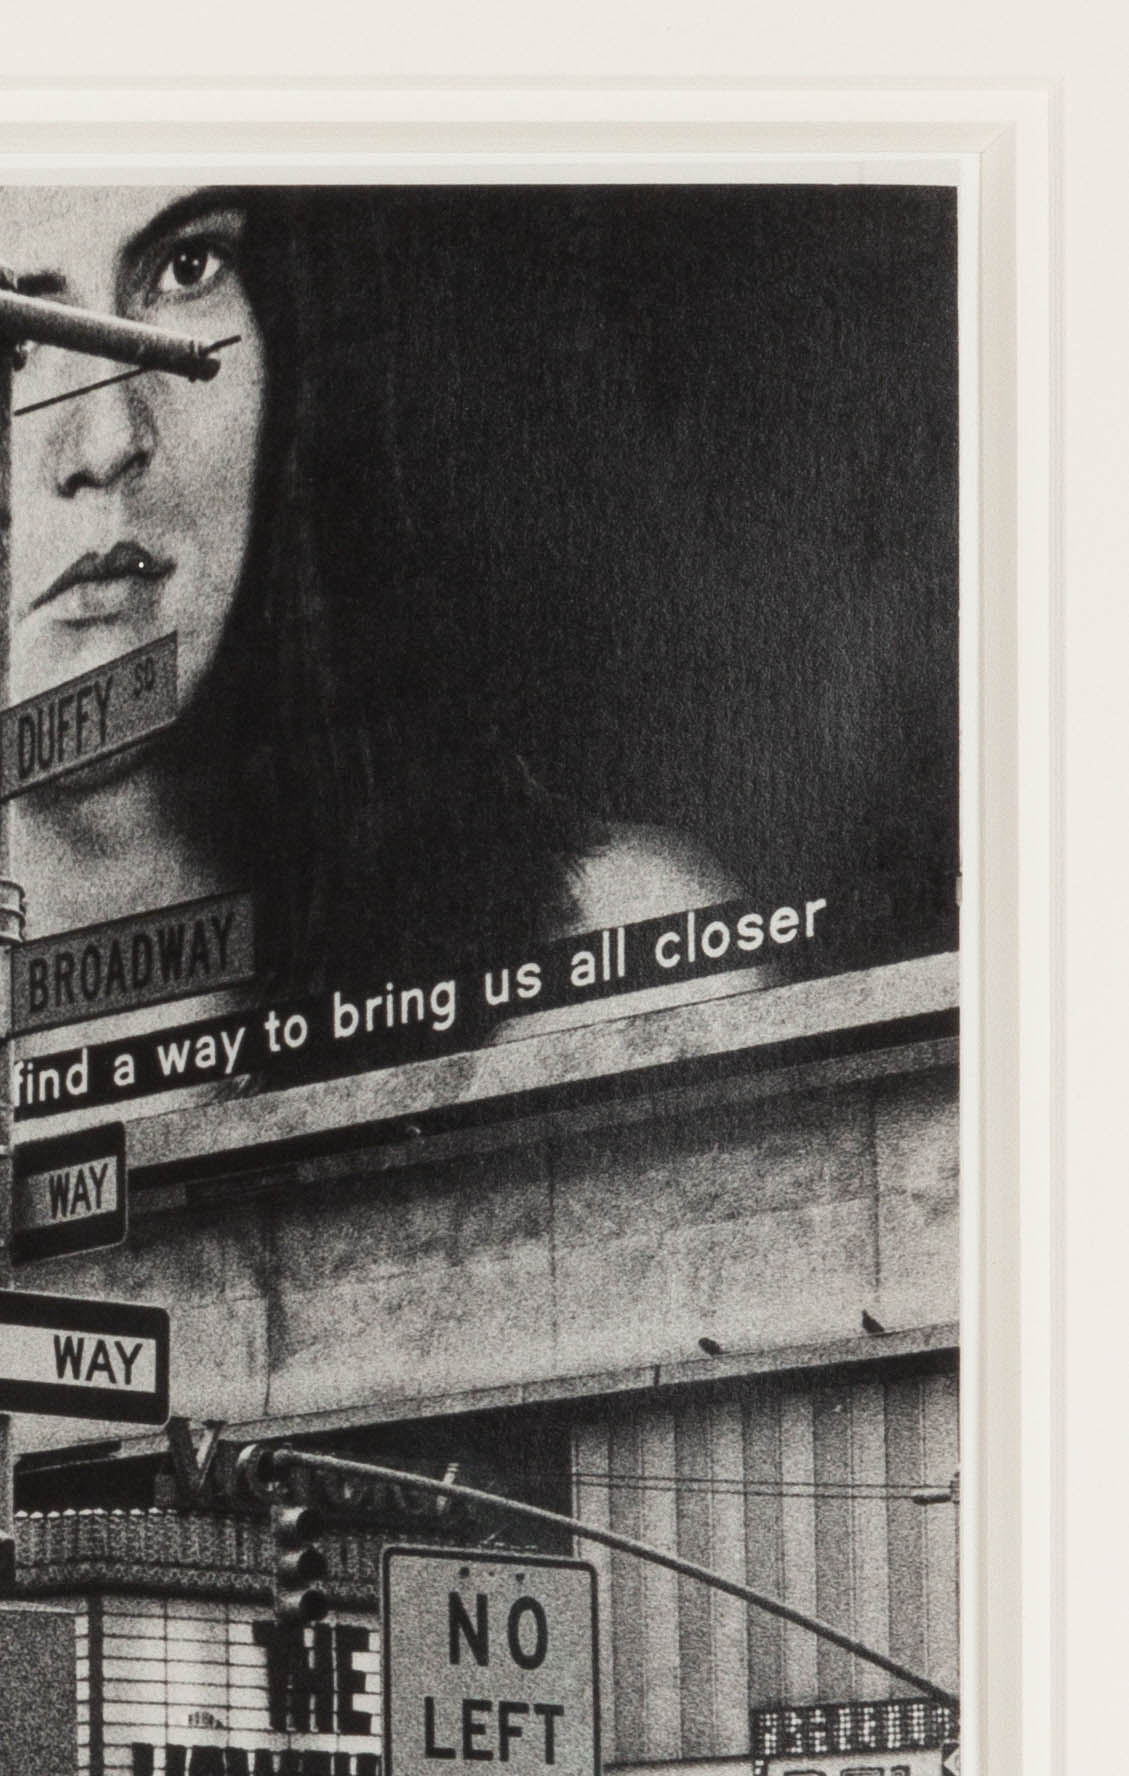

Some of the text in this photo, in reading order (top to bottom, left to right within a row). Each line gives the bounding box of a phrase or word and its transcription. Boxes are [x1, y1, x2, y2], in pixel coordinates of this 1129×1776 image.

[17, 677, 113, 779] DUFFY
[14, 1048, 87, 1108] find
[115, 1053, 136, 1086] a
[160, 1025, 246, 1078] way
[266, 1010, 308, 1052] to
[333, 979, 456, 1039] bring
[484, 963, 541, 1005] us
[570, 928, 626, 986] all
[655, 898, 827, 969] closer
[29, 913, 236, 1010] BROADWAY
[49, 1163, 109, 1216] WAY
[52, 1335, 143, 1386] WAY
[448, 1591, 548, 1670] NO
[252, 1620, 373, 1734] THE
[425, 1696, 565, 1765] LEFT
